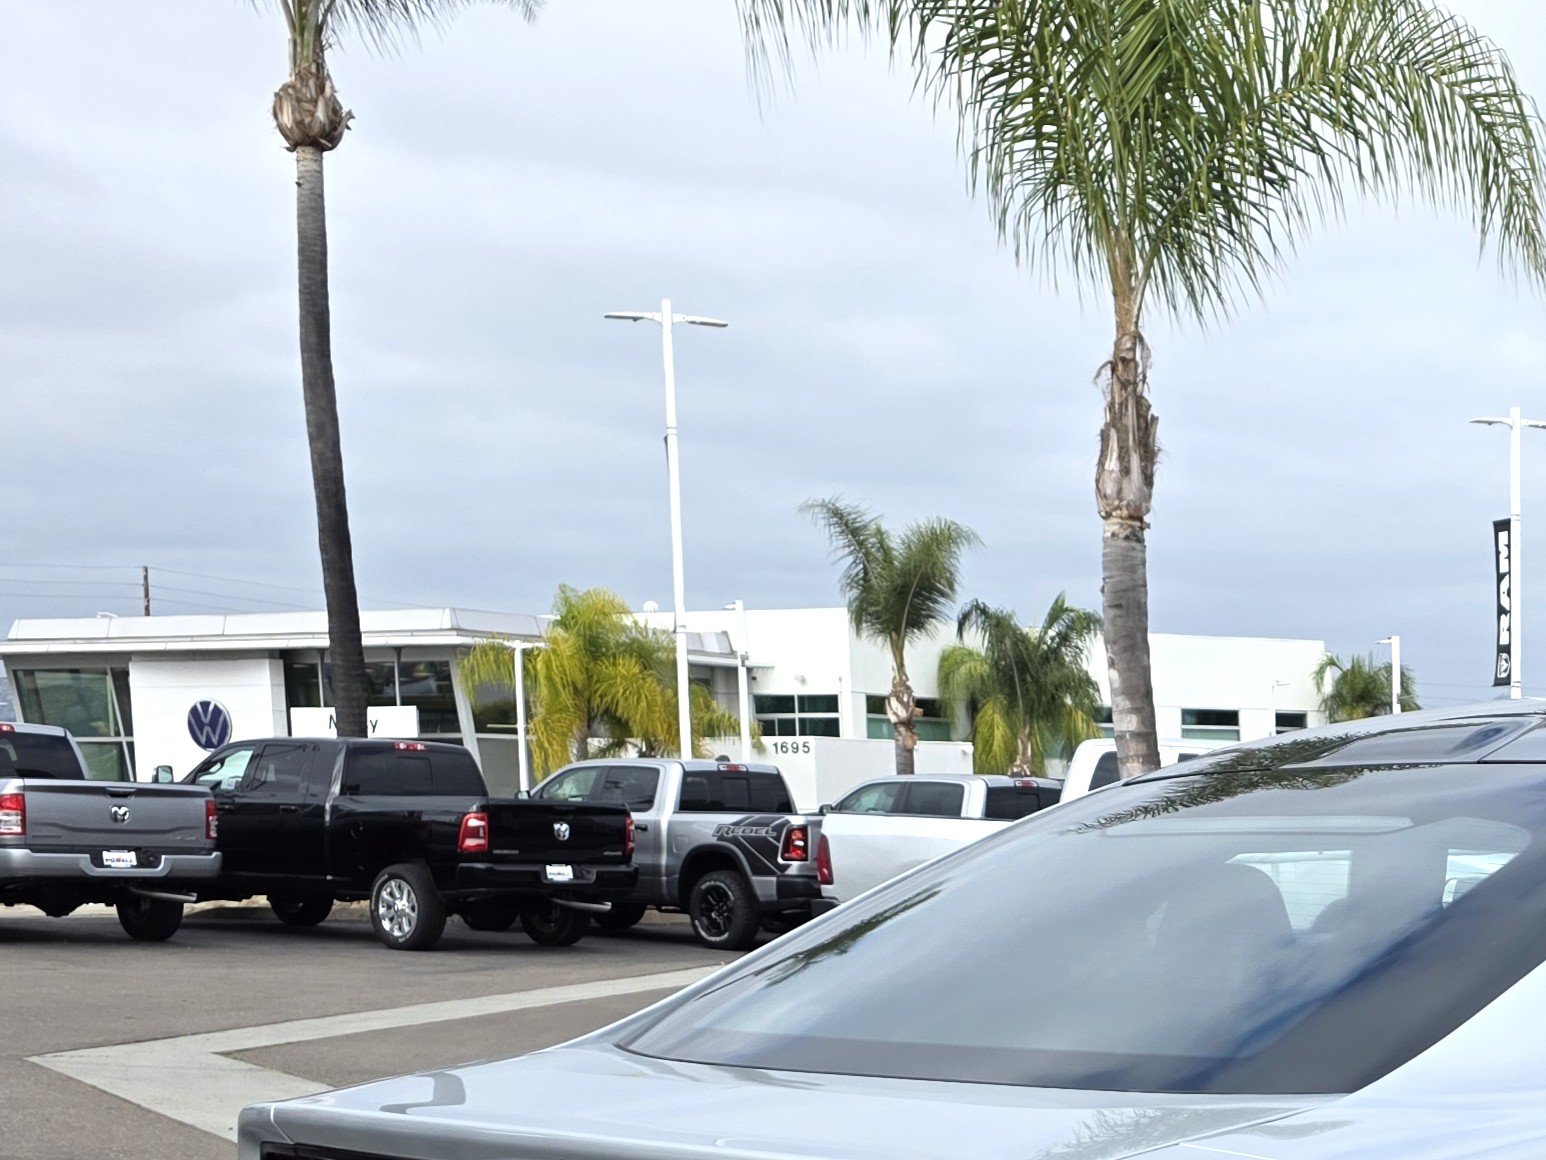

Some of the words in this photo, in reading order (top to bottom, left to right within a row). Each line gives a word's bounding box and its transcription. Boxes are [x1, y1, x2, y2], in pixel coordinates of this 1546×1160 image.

[1498, 531, 1510, 645] RAM
[772, 741, 811, 755] 1695
[712, 824, 778, 838] REBEL
